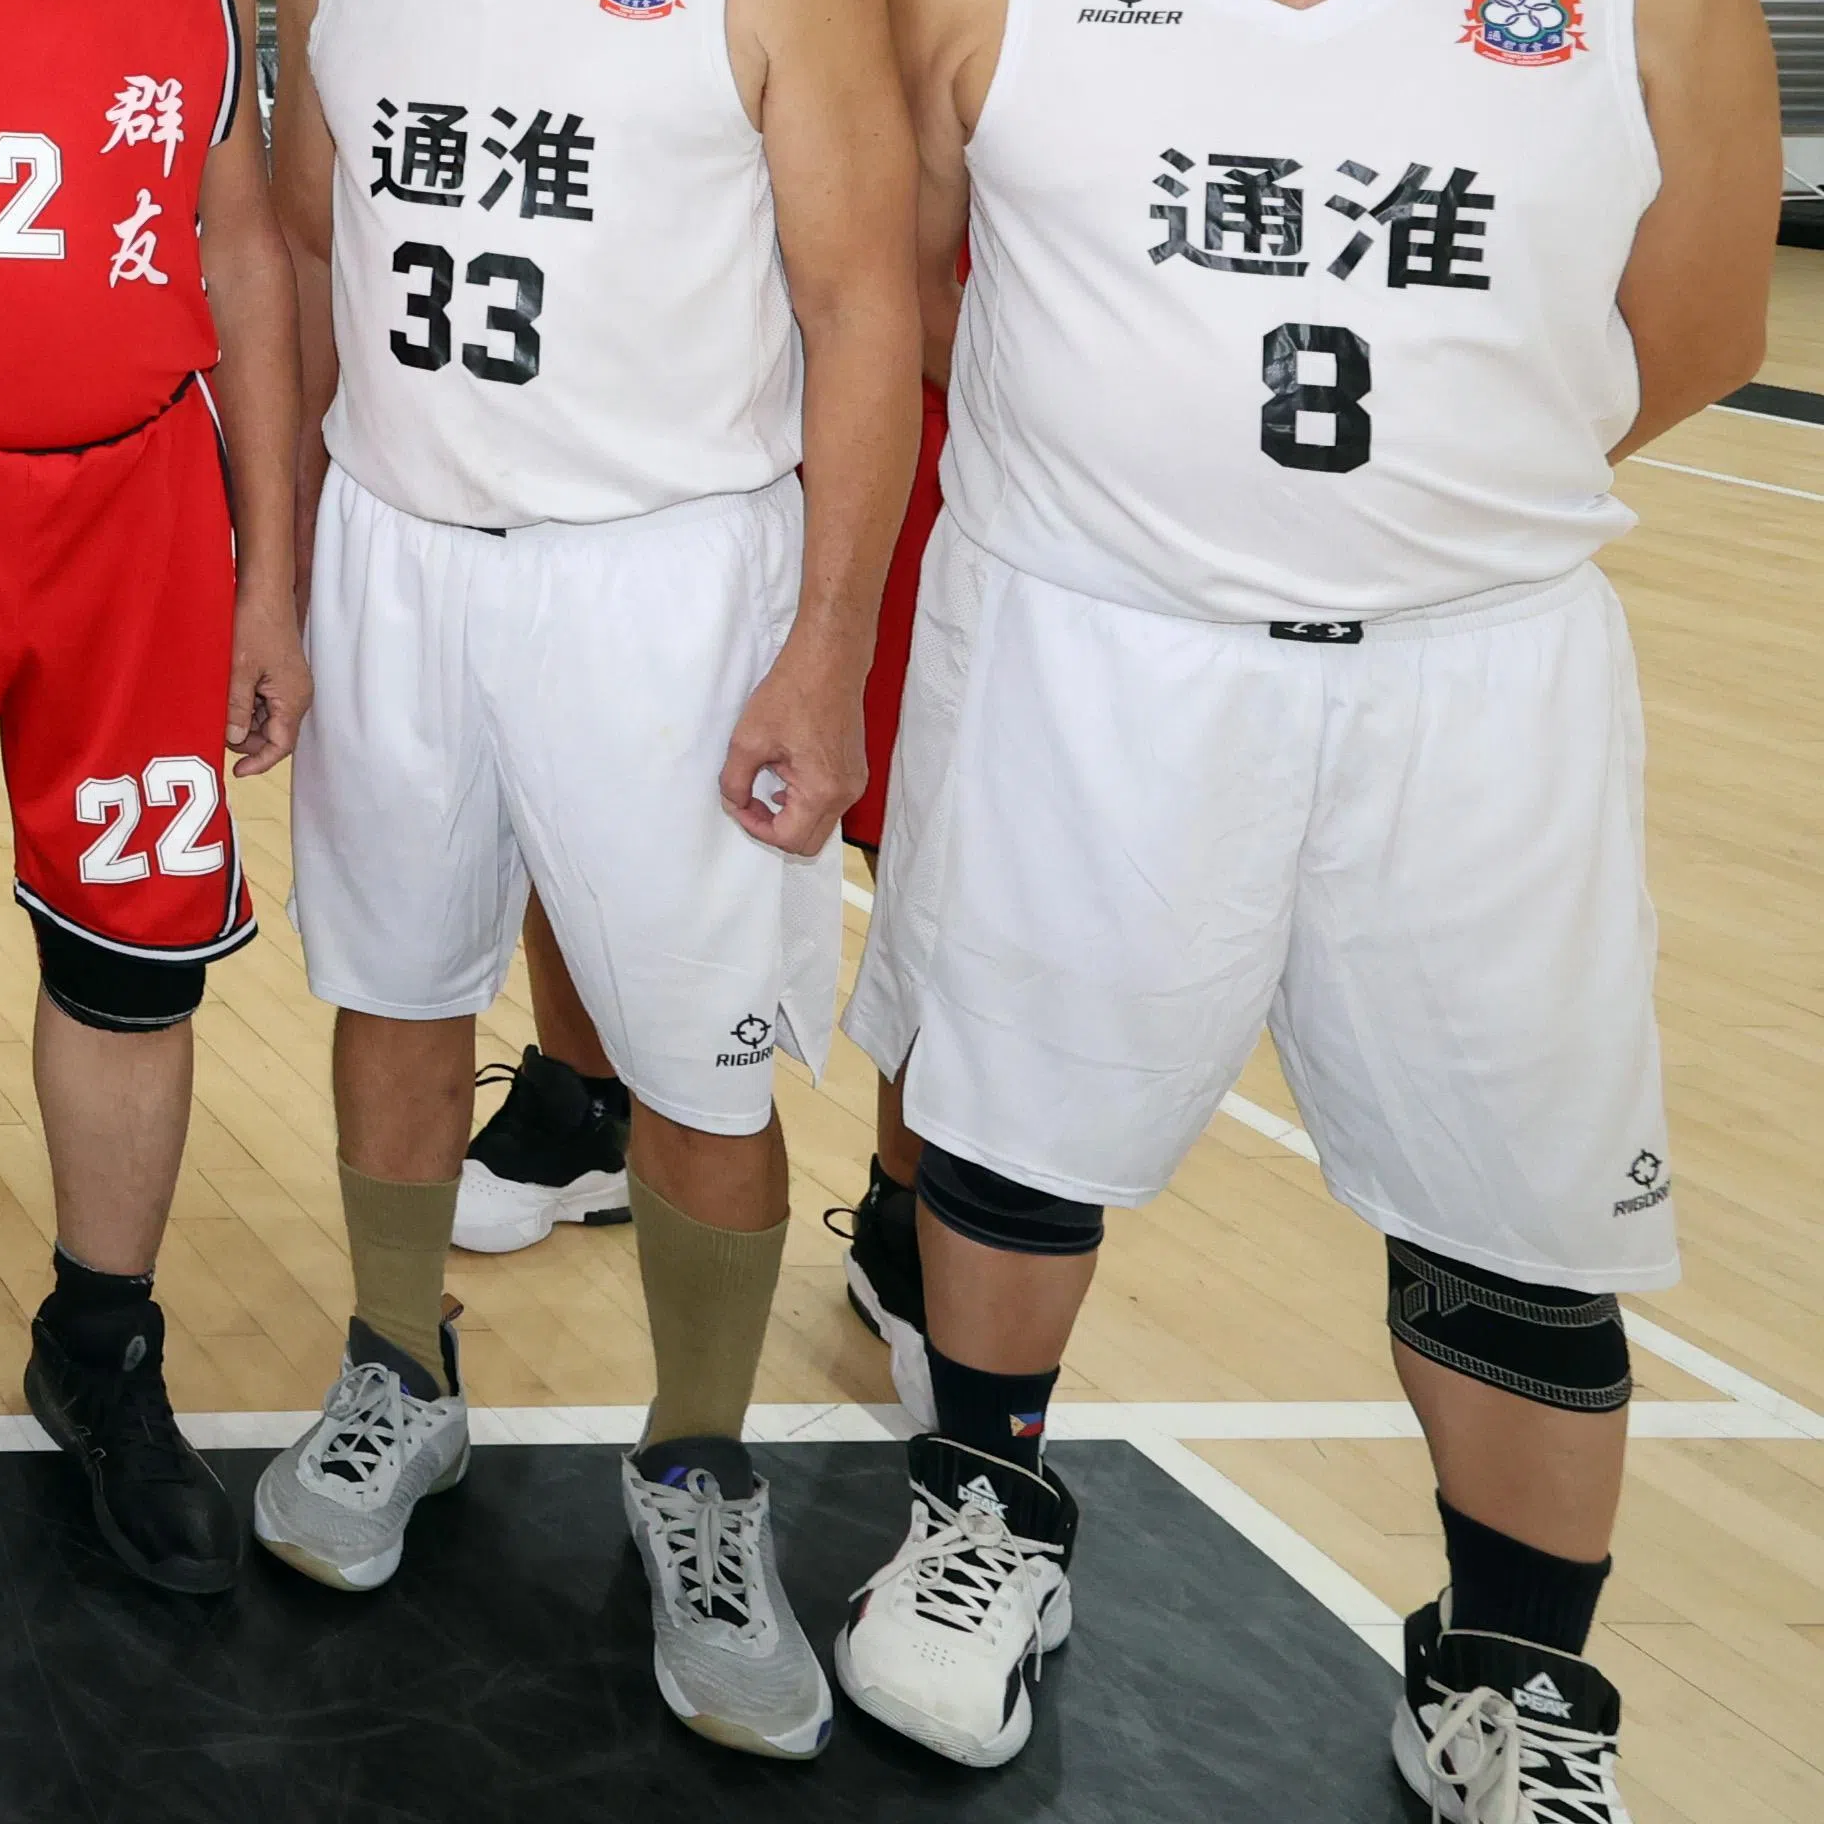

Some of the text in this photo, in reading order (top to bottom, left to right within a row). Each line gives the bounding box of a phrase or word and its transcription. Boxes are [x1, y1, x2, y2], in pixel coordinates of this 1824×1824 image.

[1077, 8, 1183, 25] RIGORER
[369, 96, 596, 222] 通淮
[1147, 146, 1496, 291] 通淮
[389, 240, 545, 387] 33
[1260, 322, 1372, 474] 8
[76, 754, 226, 885] 22
